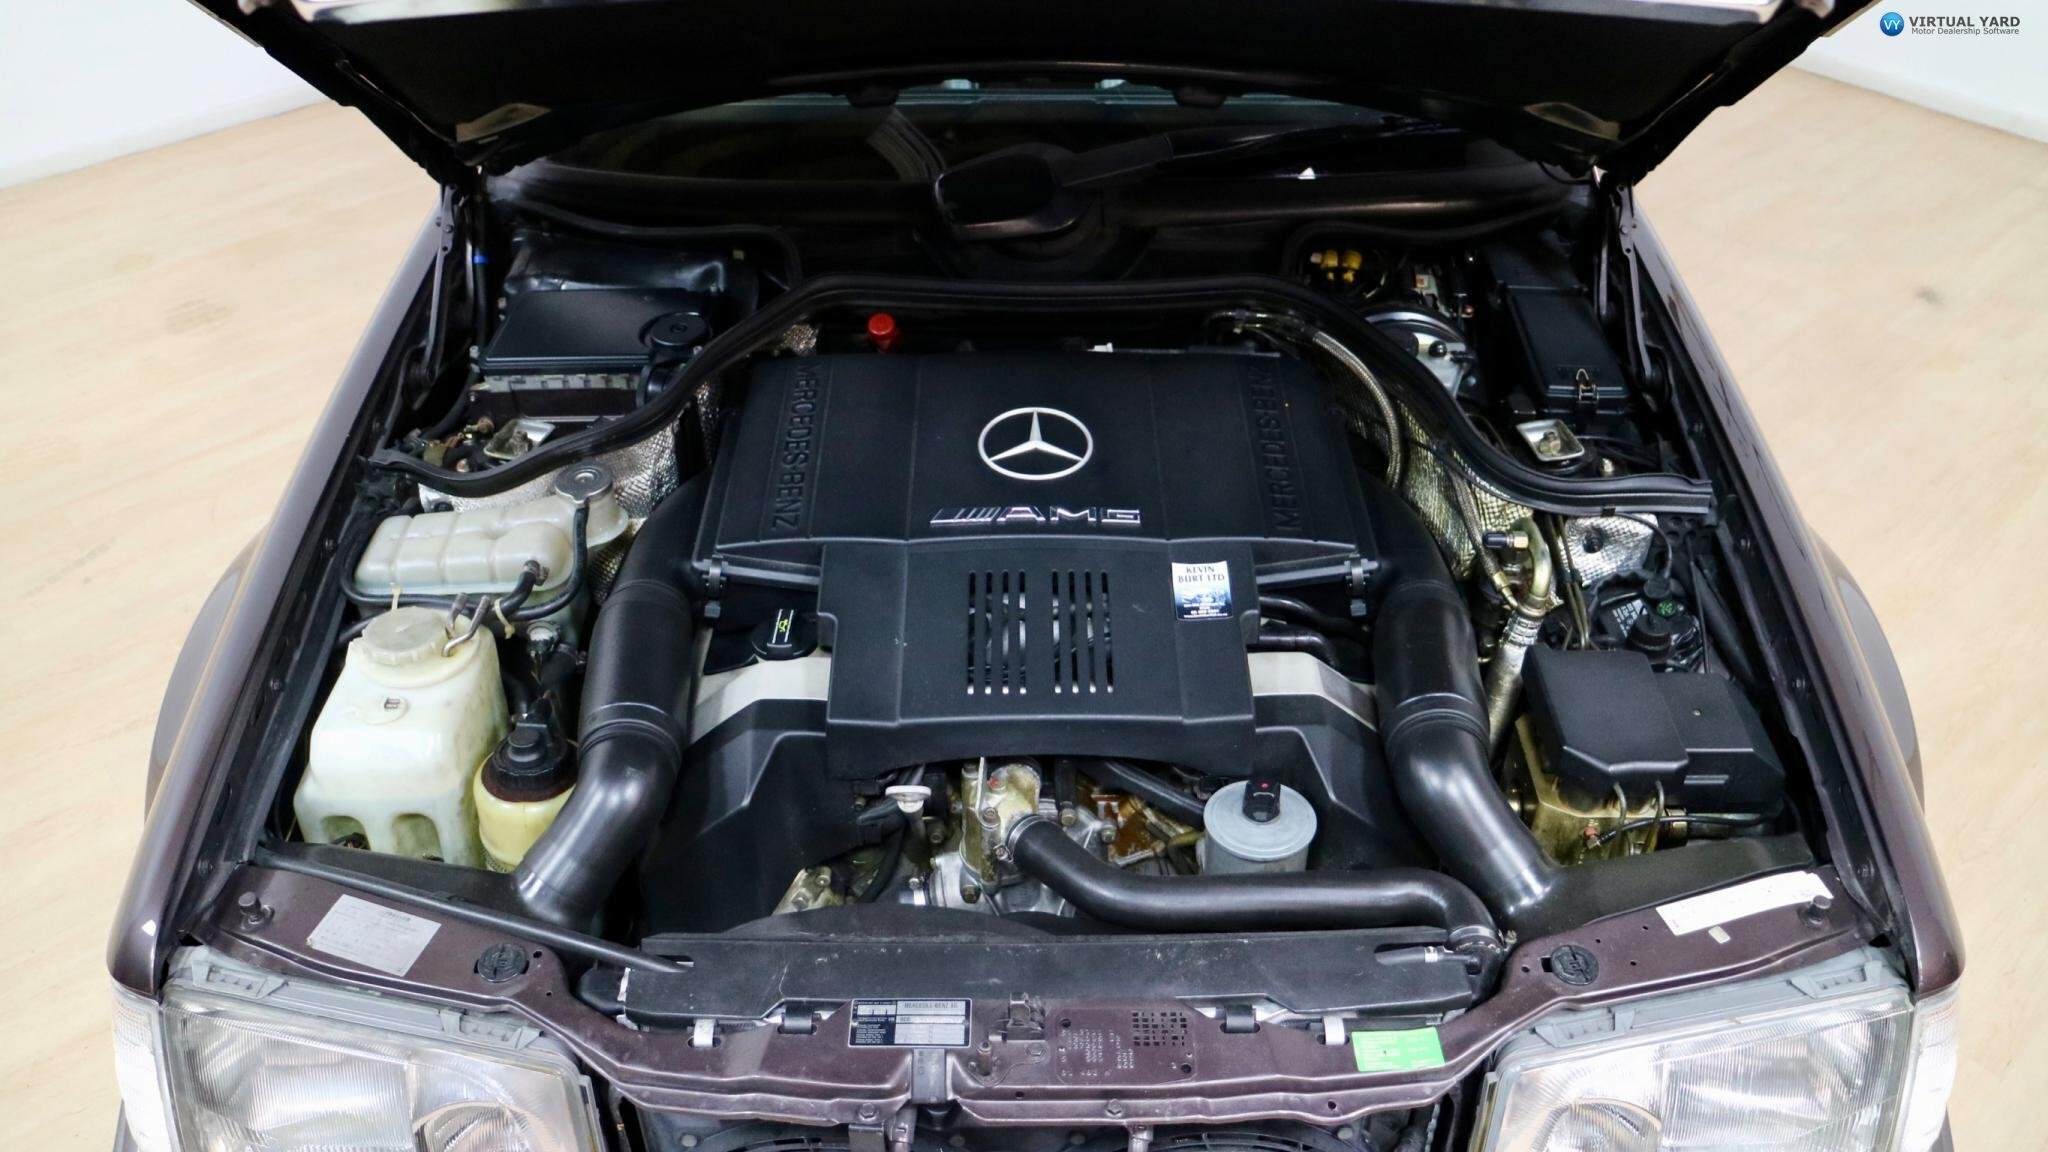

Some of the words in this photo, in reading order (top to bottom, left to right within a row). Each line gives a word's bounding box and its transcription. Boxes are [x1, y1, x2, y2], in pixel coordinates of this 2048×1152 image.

[996, 505, 1141, 524] AMG
[1186, 565, 1215, 574] KEVIN
[1178, 574, 1204, 583] BURT
